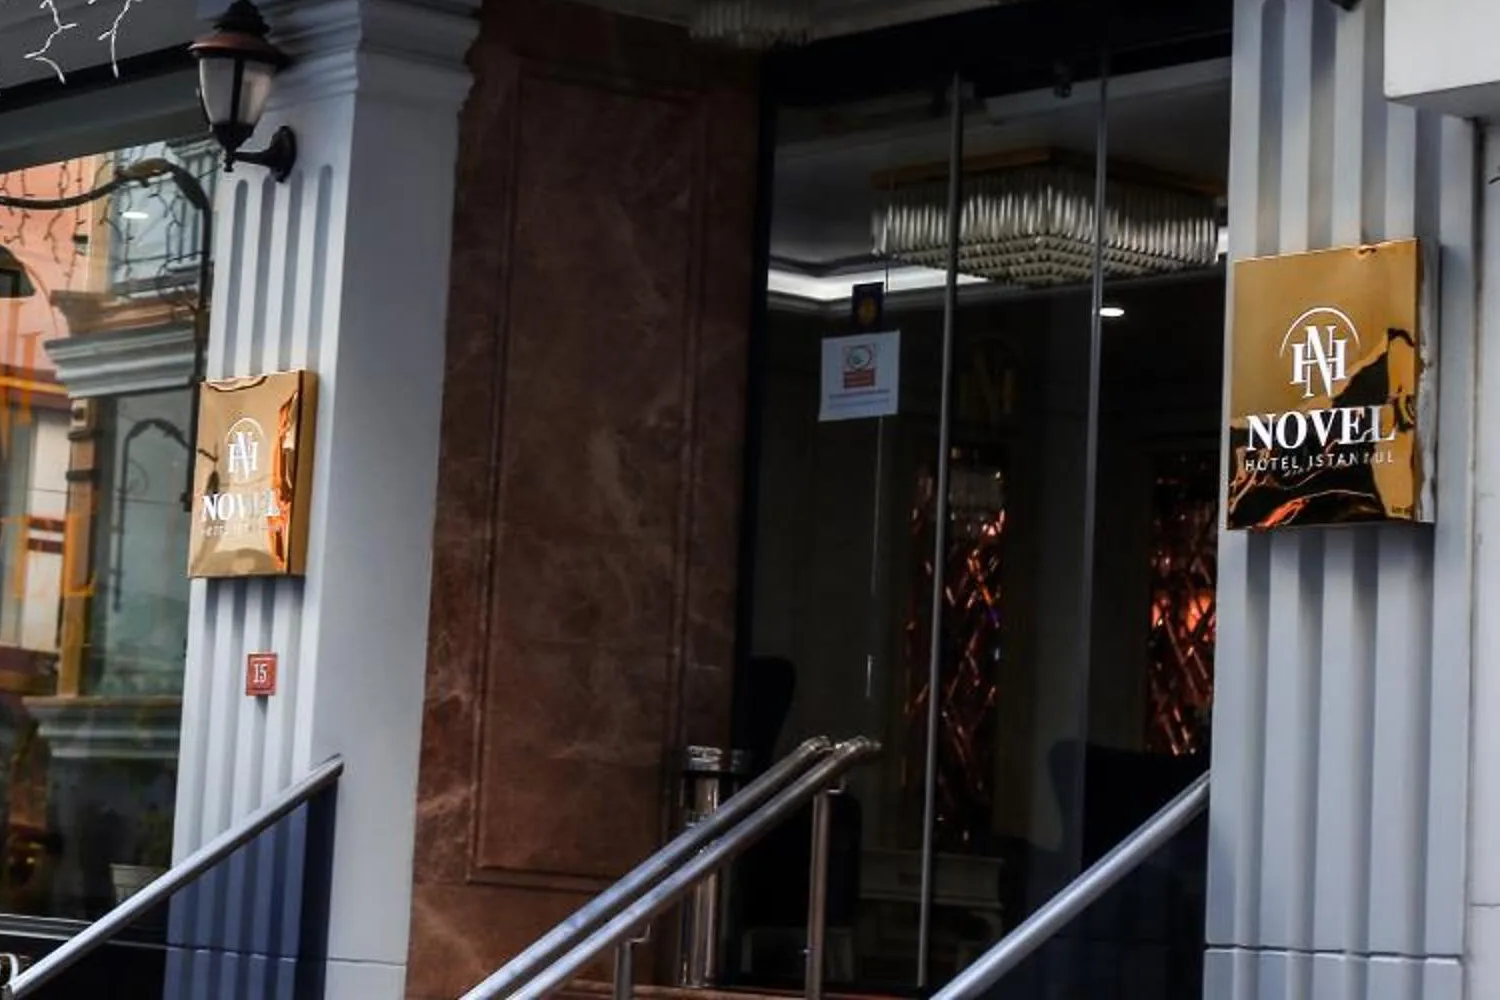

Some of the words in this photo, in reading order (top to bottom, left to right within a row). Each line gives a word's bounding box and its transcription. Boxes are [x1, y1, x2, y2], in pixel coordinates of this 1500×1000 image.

[1245, 404, 1397, 452] NOVEL
[1244, 456, 1299, 473] HOTEL
[252, 663, 268, 683] 15
